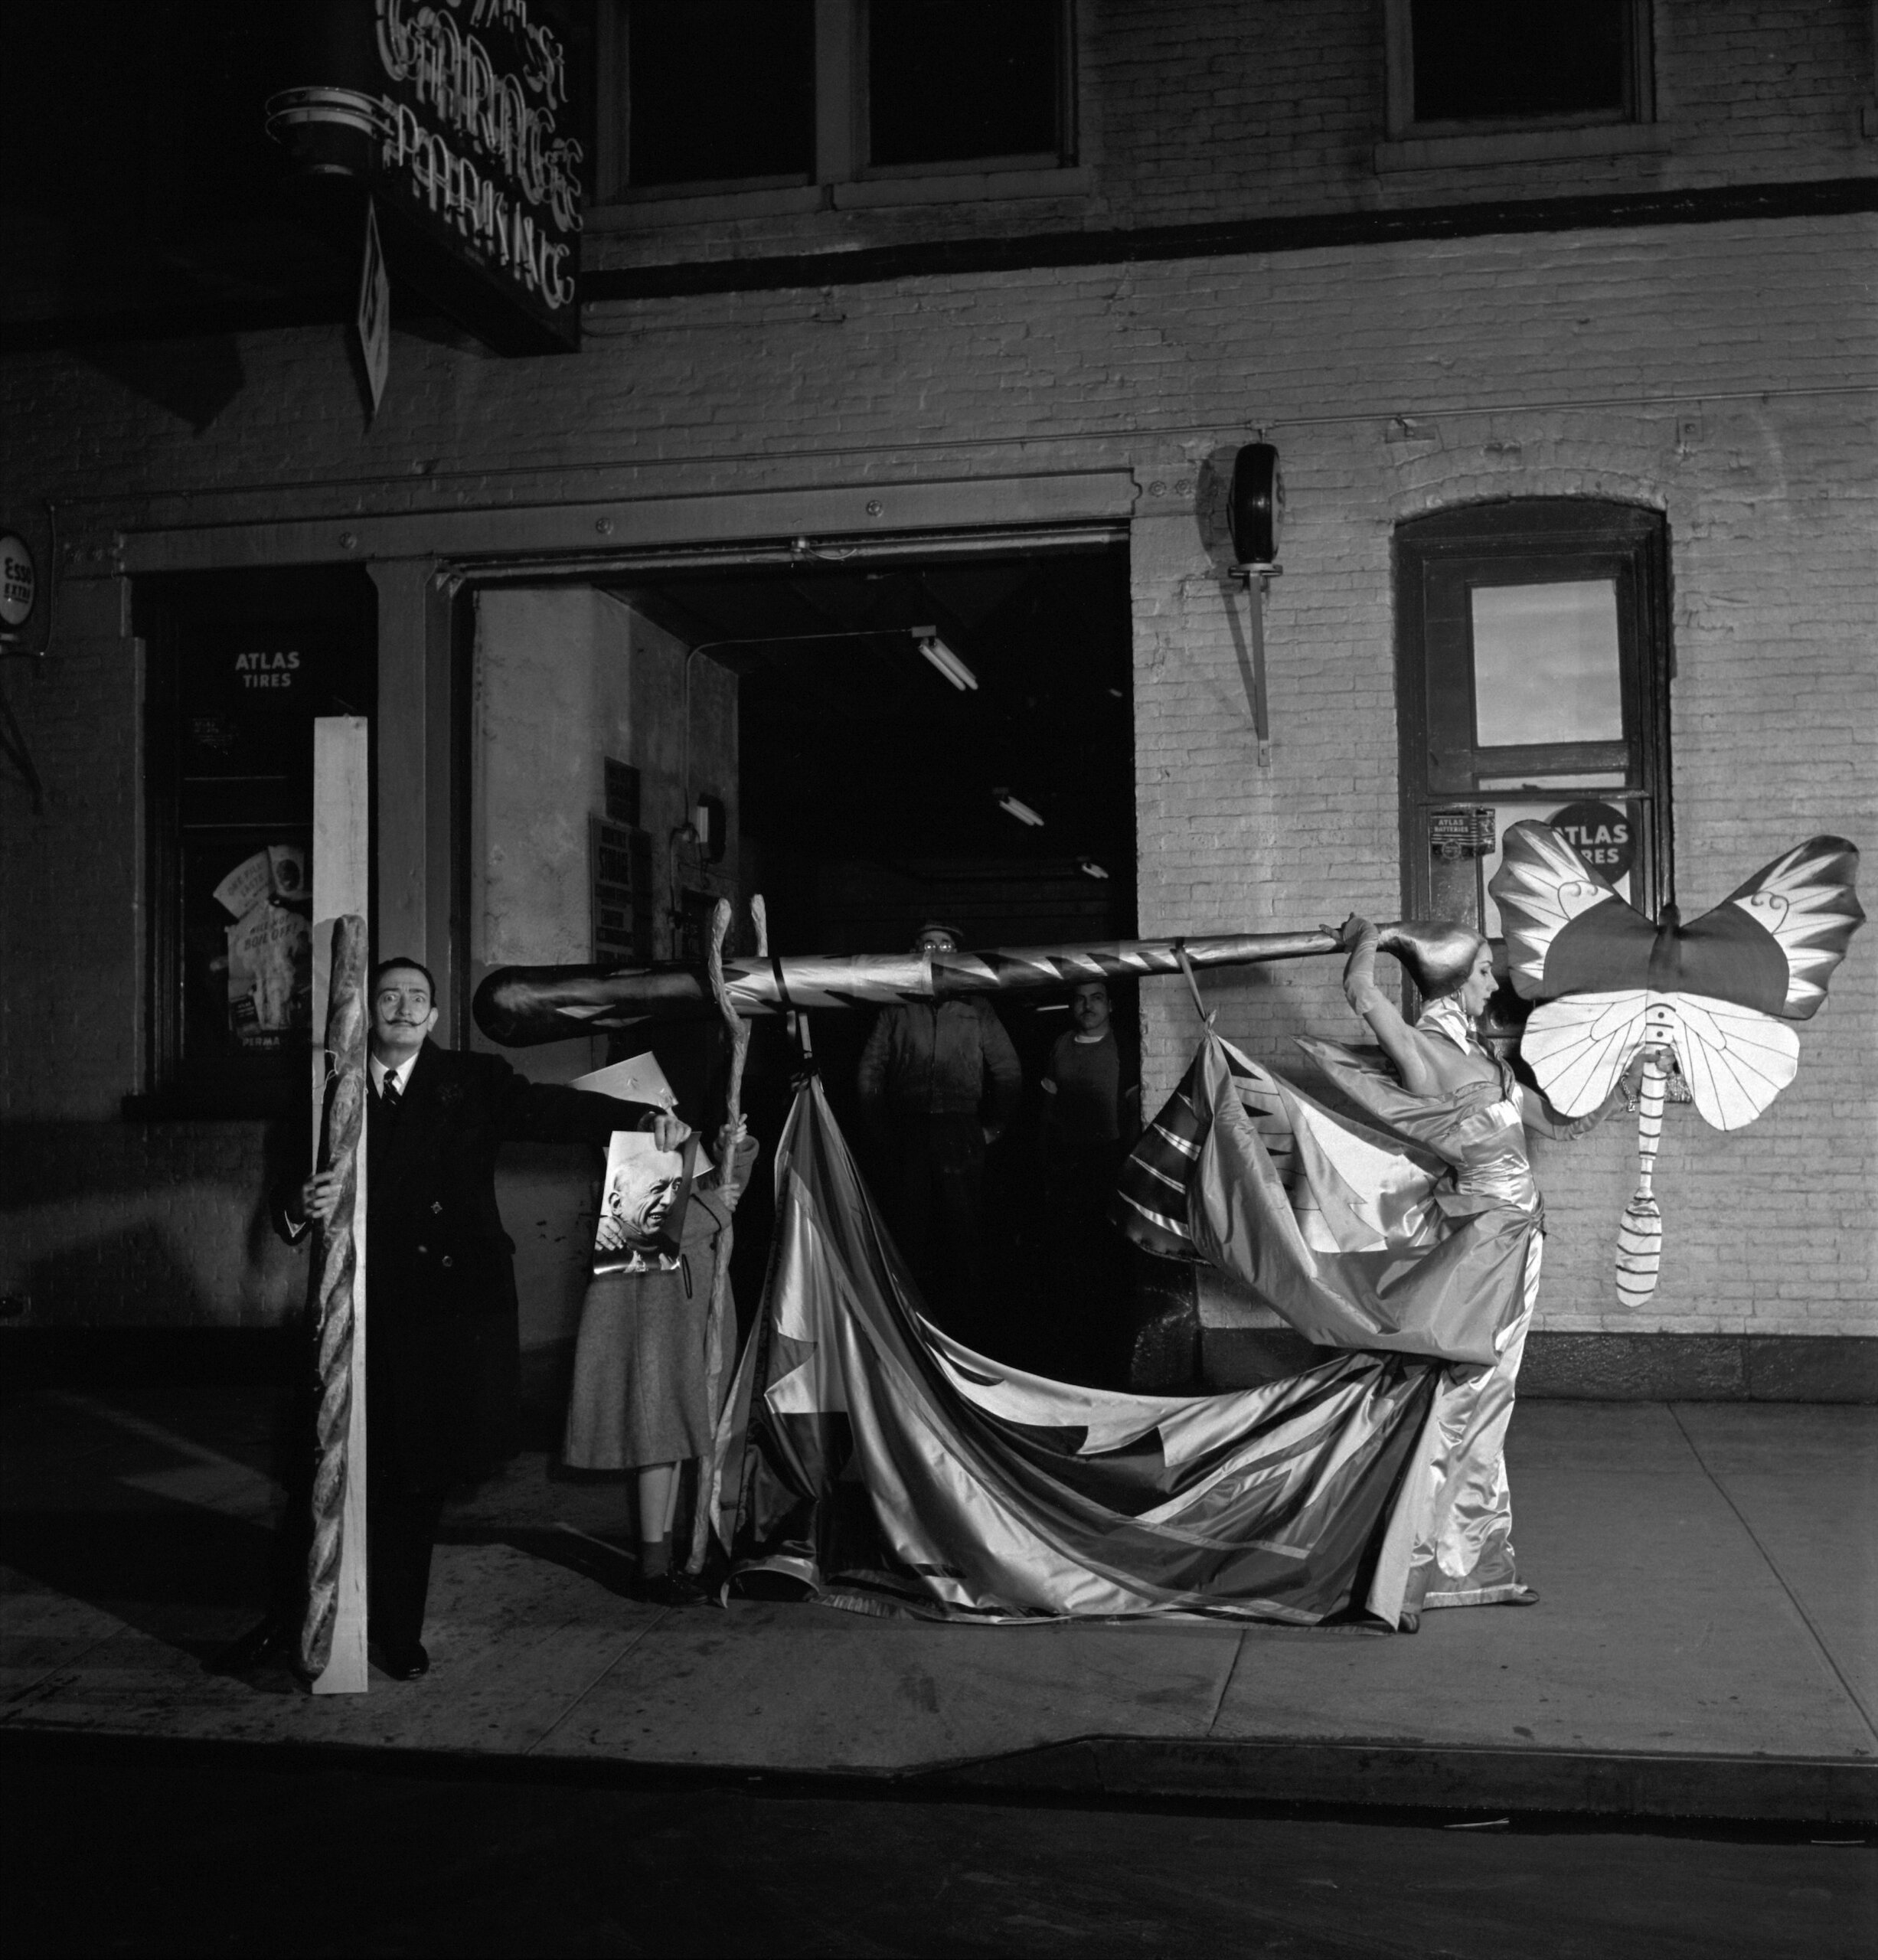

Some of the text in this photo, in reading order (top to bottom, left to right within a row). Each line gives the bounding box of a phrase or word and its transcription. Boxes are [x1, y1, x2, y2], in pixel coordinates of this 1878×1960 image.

[235, 652, 301, 671] ATLAS
[243, 672, 292, 688] TIRES
[1555, 824, 1628, 845] TLAS
[1580, 848, 1619, 864] RES
[244, 933, 268, 950] BOIL
